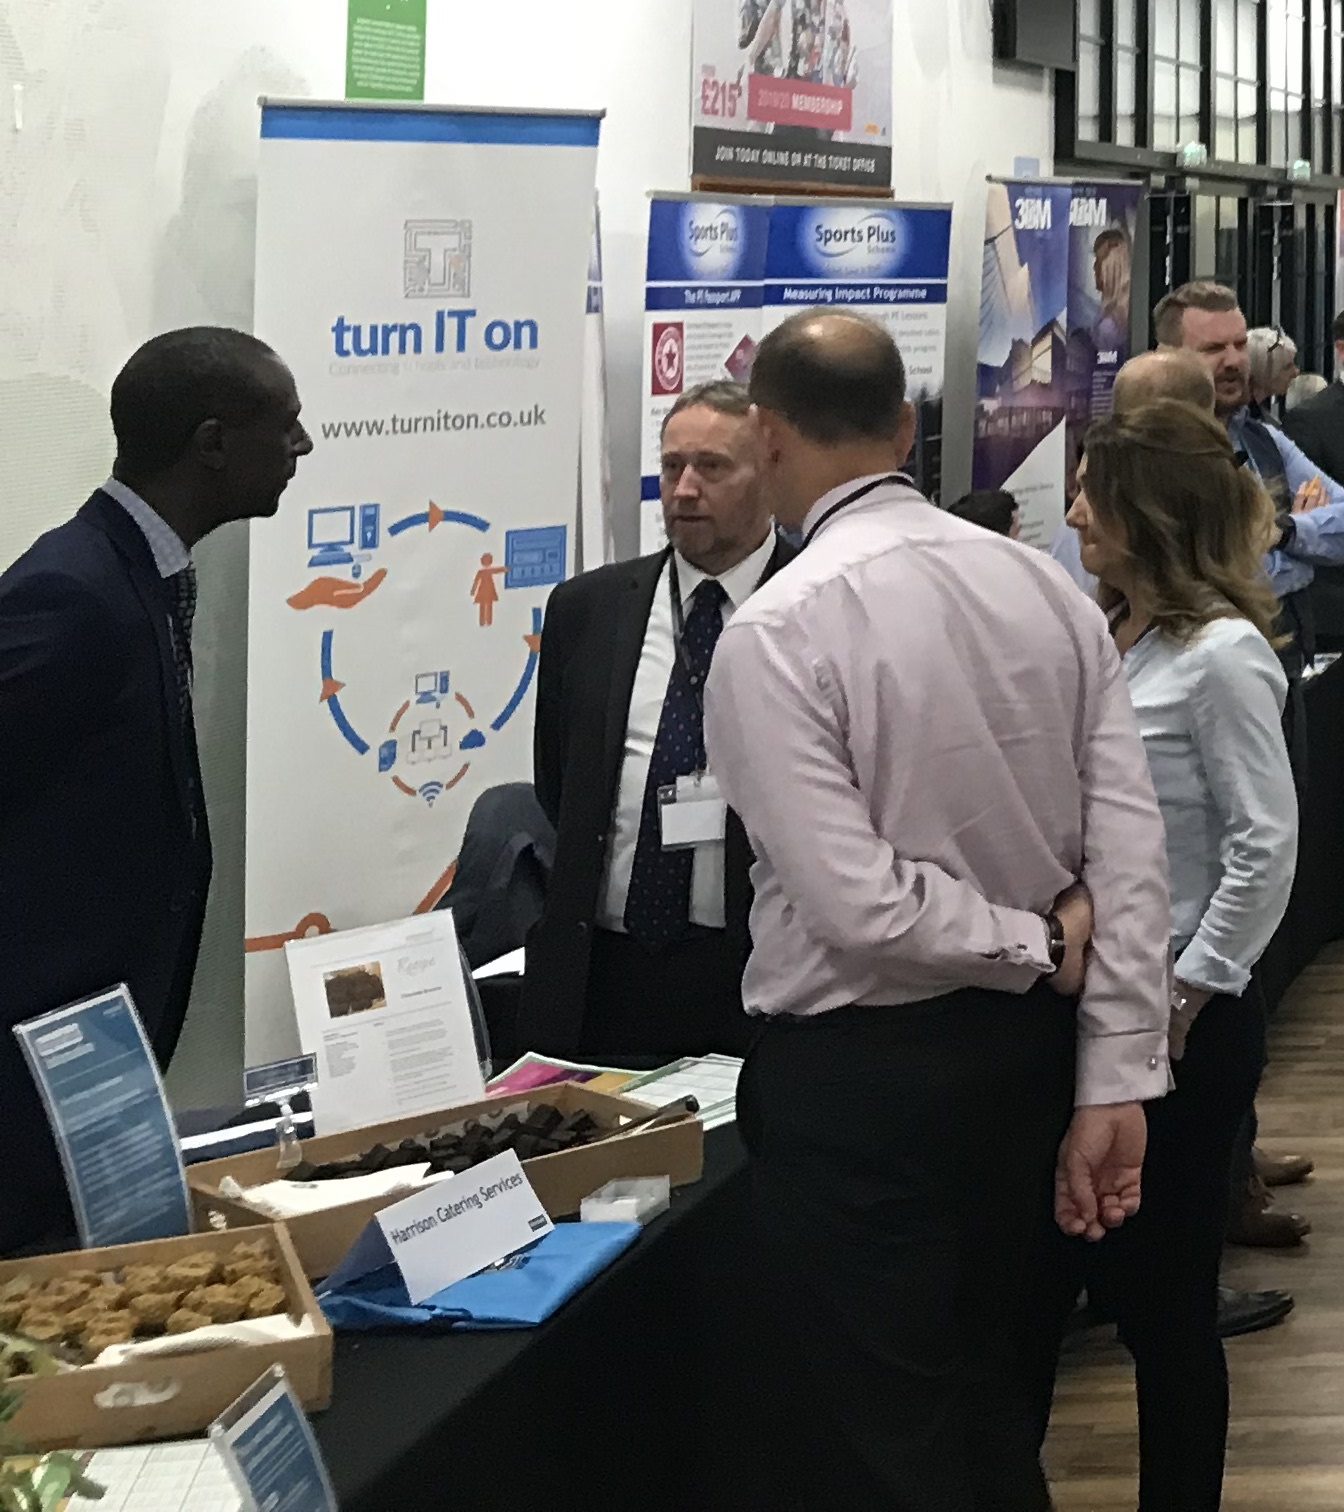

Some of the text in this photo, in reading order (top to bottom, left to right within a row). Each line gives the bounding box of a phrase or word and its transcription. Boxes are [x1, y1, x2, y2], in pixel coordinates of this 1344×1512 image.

[689, 220, 718, 245] Sports
[815, 223, 896, 246] Sports Plus
[783, 286, 927, 303] Measuring Impact Programme
[331, 308, 539, 358] turn IT on
[321, 404, 547, 440] www.turniton.co.uk
[389, 1171, 524, 1246] Harrison Catering Services
